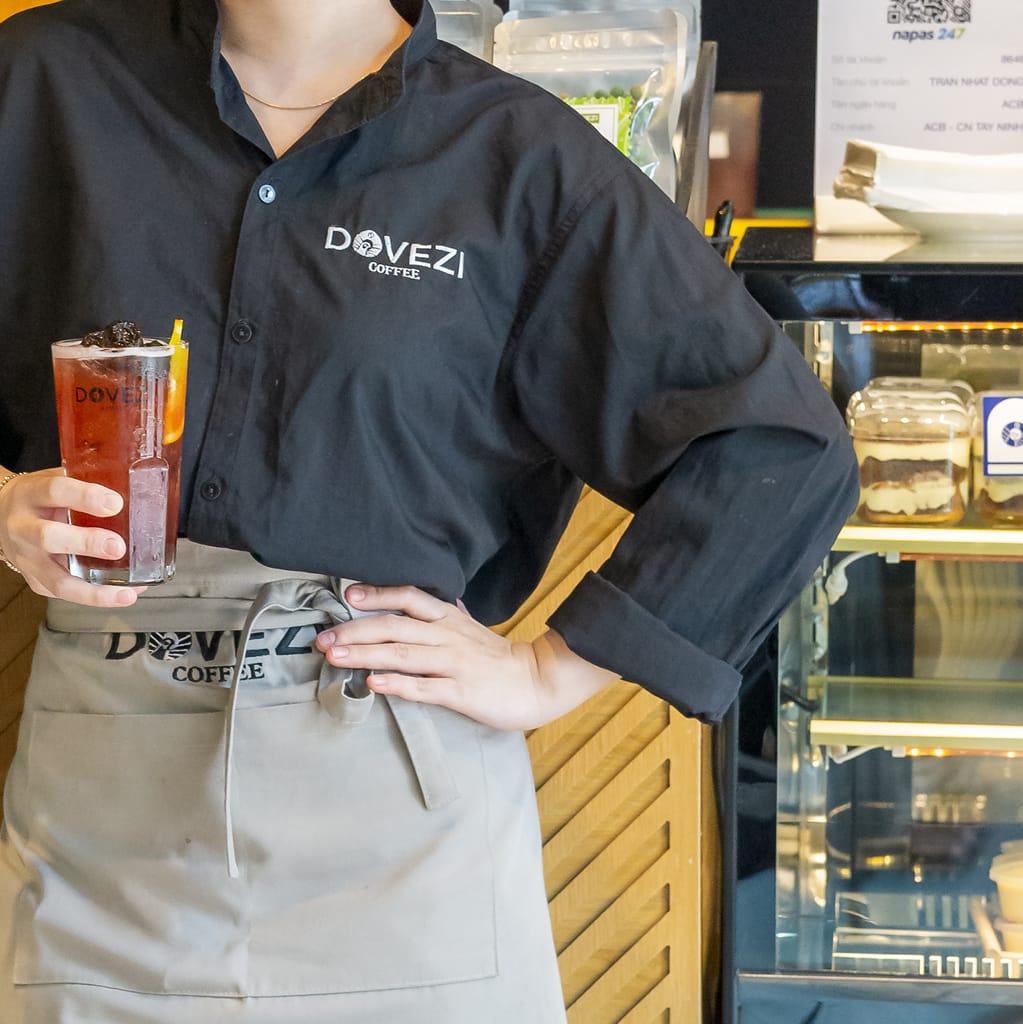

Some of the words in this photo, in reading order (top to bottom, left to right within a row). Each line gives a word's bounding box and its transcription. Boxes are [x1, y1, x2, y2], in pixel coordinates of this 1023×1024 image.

[892, 29, 934, 43] napas
[937, 28, 965, 40] 247
[325, 226, 464, 279] DOVEZI
[368, 261, 420, 280] COFFEE
[172, 663, 265, 683] COFFEE
